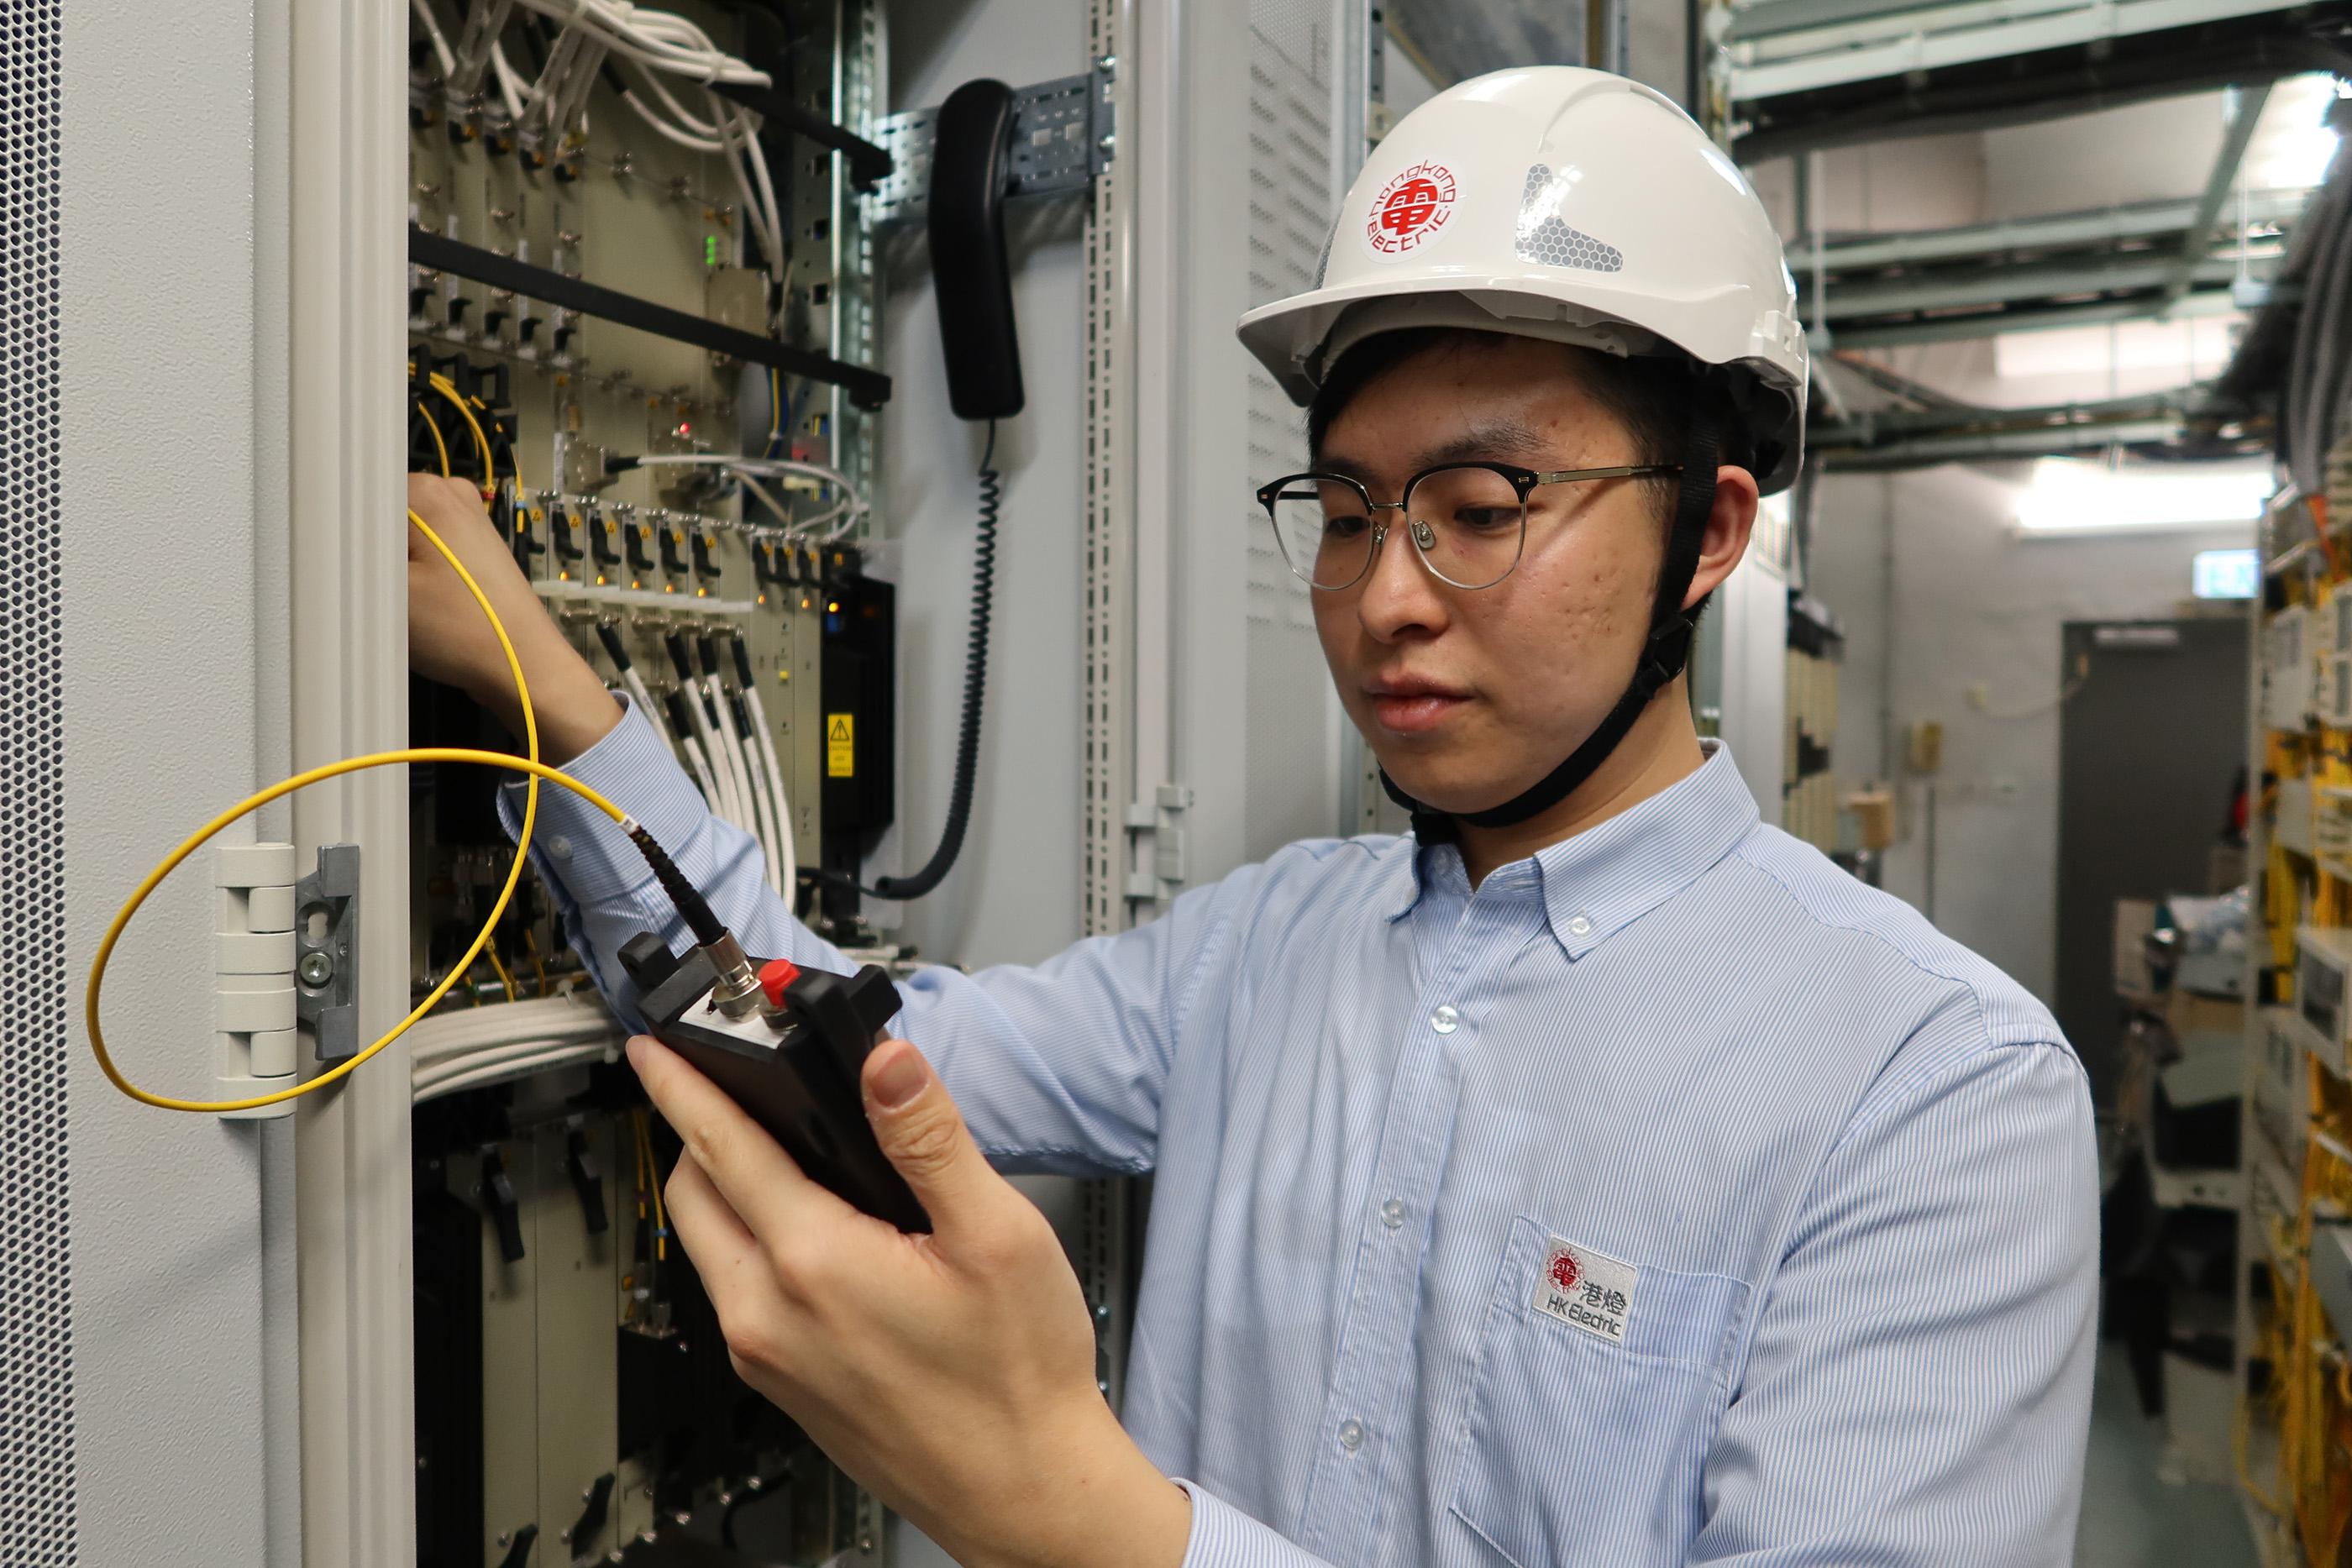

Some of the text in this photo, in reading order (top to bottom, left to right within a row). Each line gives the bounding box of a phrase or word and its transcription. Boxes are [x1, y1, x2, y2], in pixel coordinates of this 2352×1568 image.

[1381, 178, 1439, 236] 電
[1546, 1294, 1621, 1336] HK Electric
[1579, 1280, 1627, 1316] 港燈
